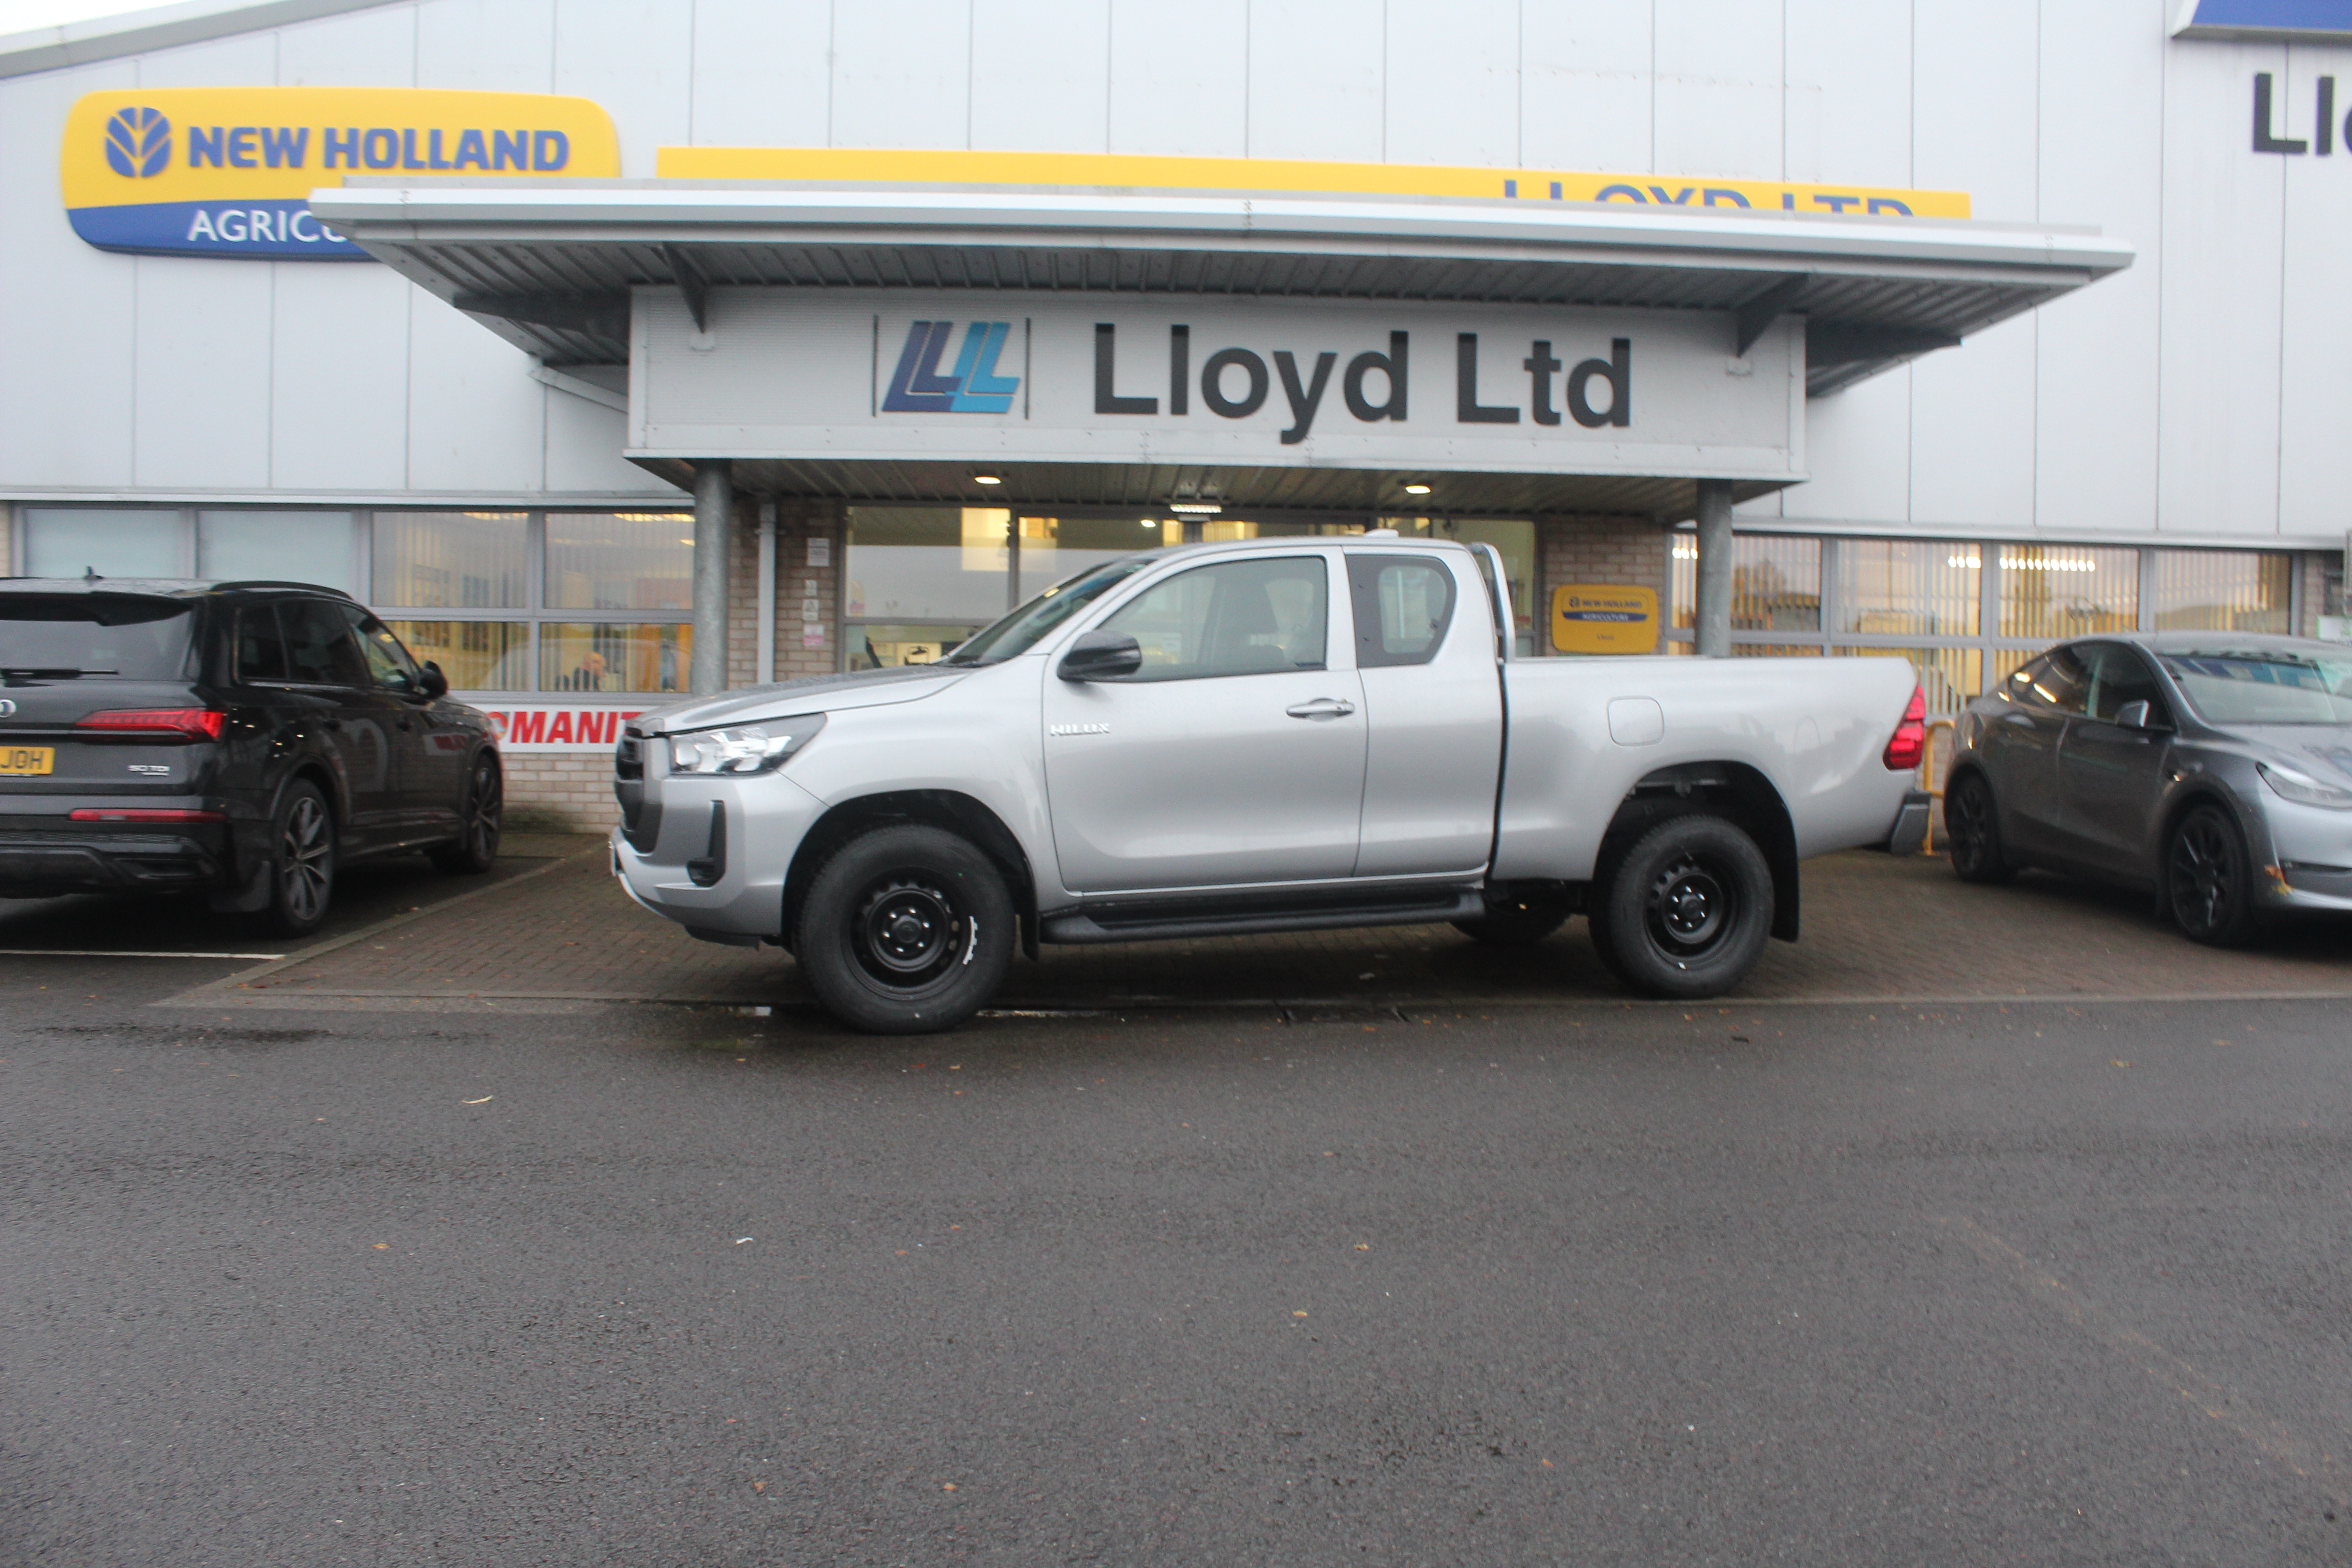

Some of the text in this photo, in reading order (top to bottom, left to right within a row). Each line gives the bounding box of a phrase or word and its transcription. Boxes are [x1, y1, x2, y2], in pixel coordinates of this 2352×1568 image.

[2253, 73, 2352, 156] Ll
[188, 127, 570, 171] NEW HOLLAND
[1094, 323, 1632, 445] Lloyd Ltd
[1050, 723, 1110, 735] HILUX
